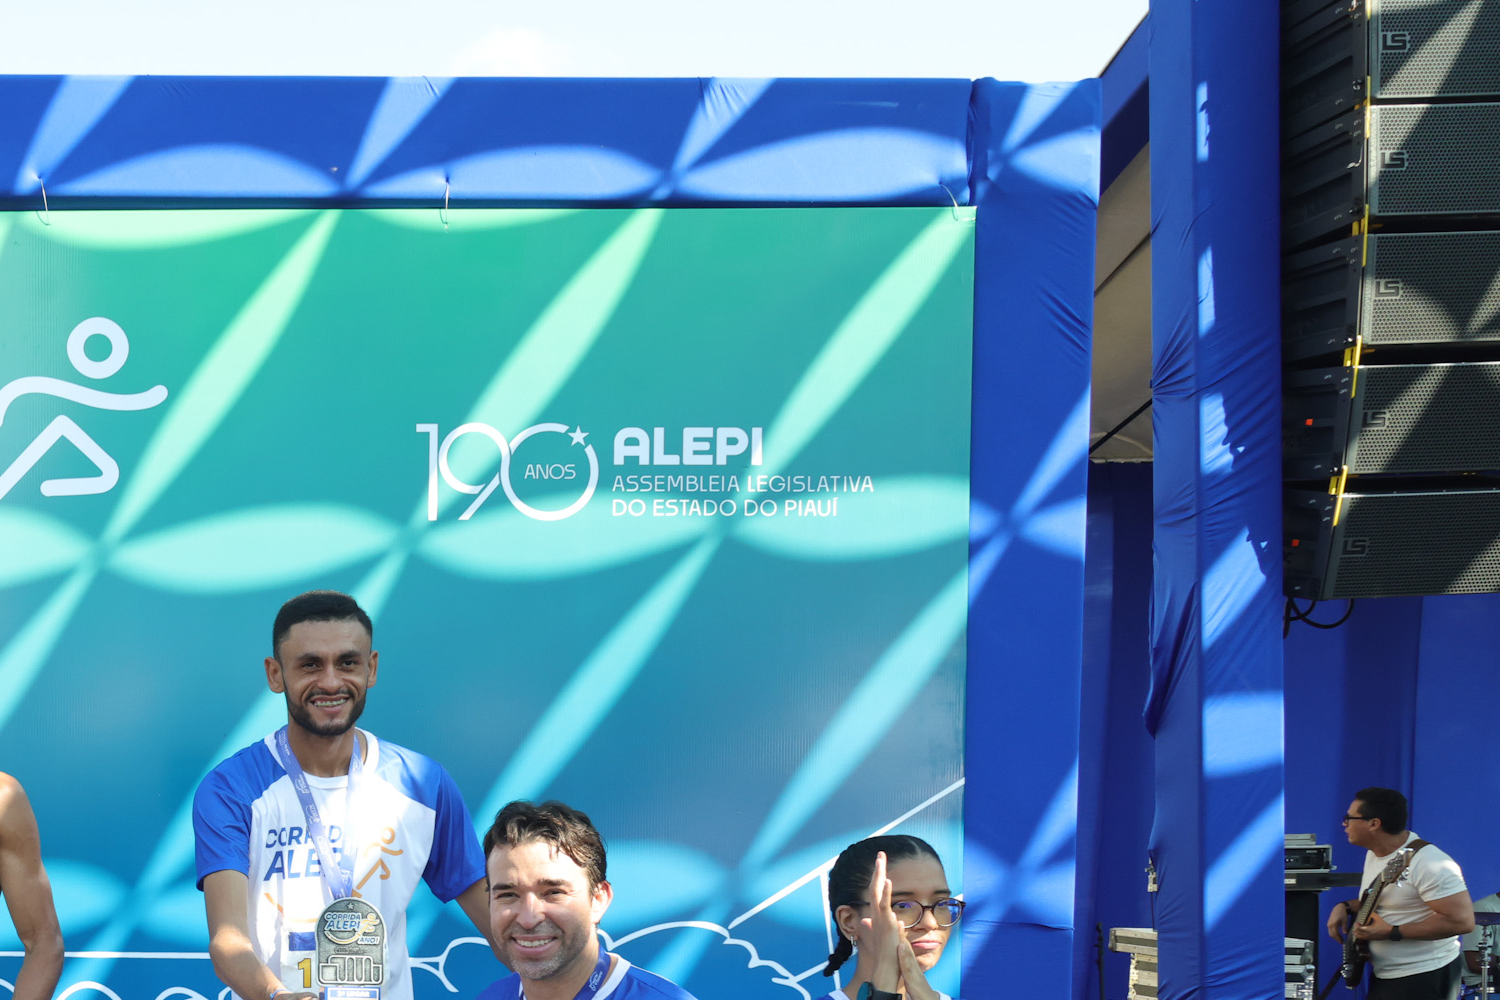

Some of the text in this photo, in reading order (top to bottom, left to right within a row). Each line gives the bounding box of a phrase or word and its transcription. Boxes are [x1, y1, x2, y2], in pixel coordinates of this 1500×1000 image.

[613, 427, 763, 465] ALEPI
[415, 422, 599, 521] 190
[524, 463, 576, 480] ANOS
[613, 475, 874, 492] ASSEMBLEIA LEGISLATIVA
[612, 496, 838, 517] DO ESTADO DO PIAUÍ
[325, 920, 361, 930] ALEPI
